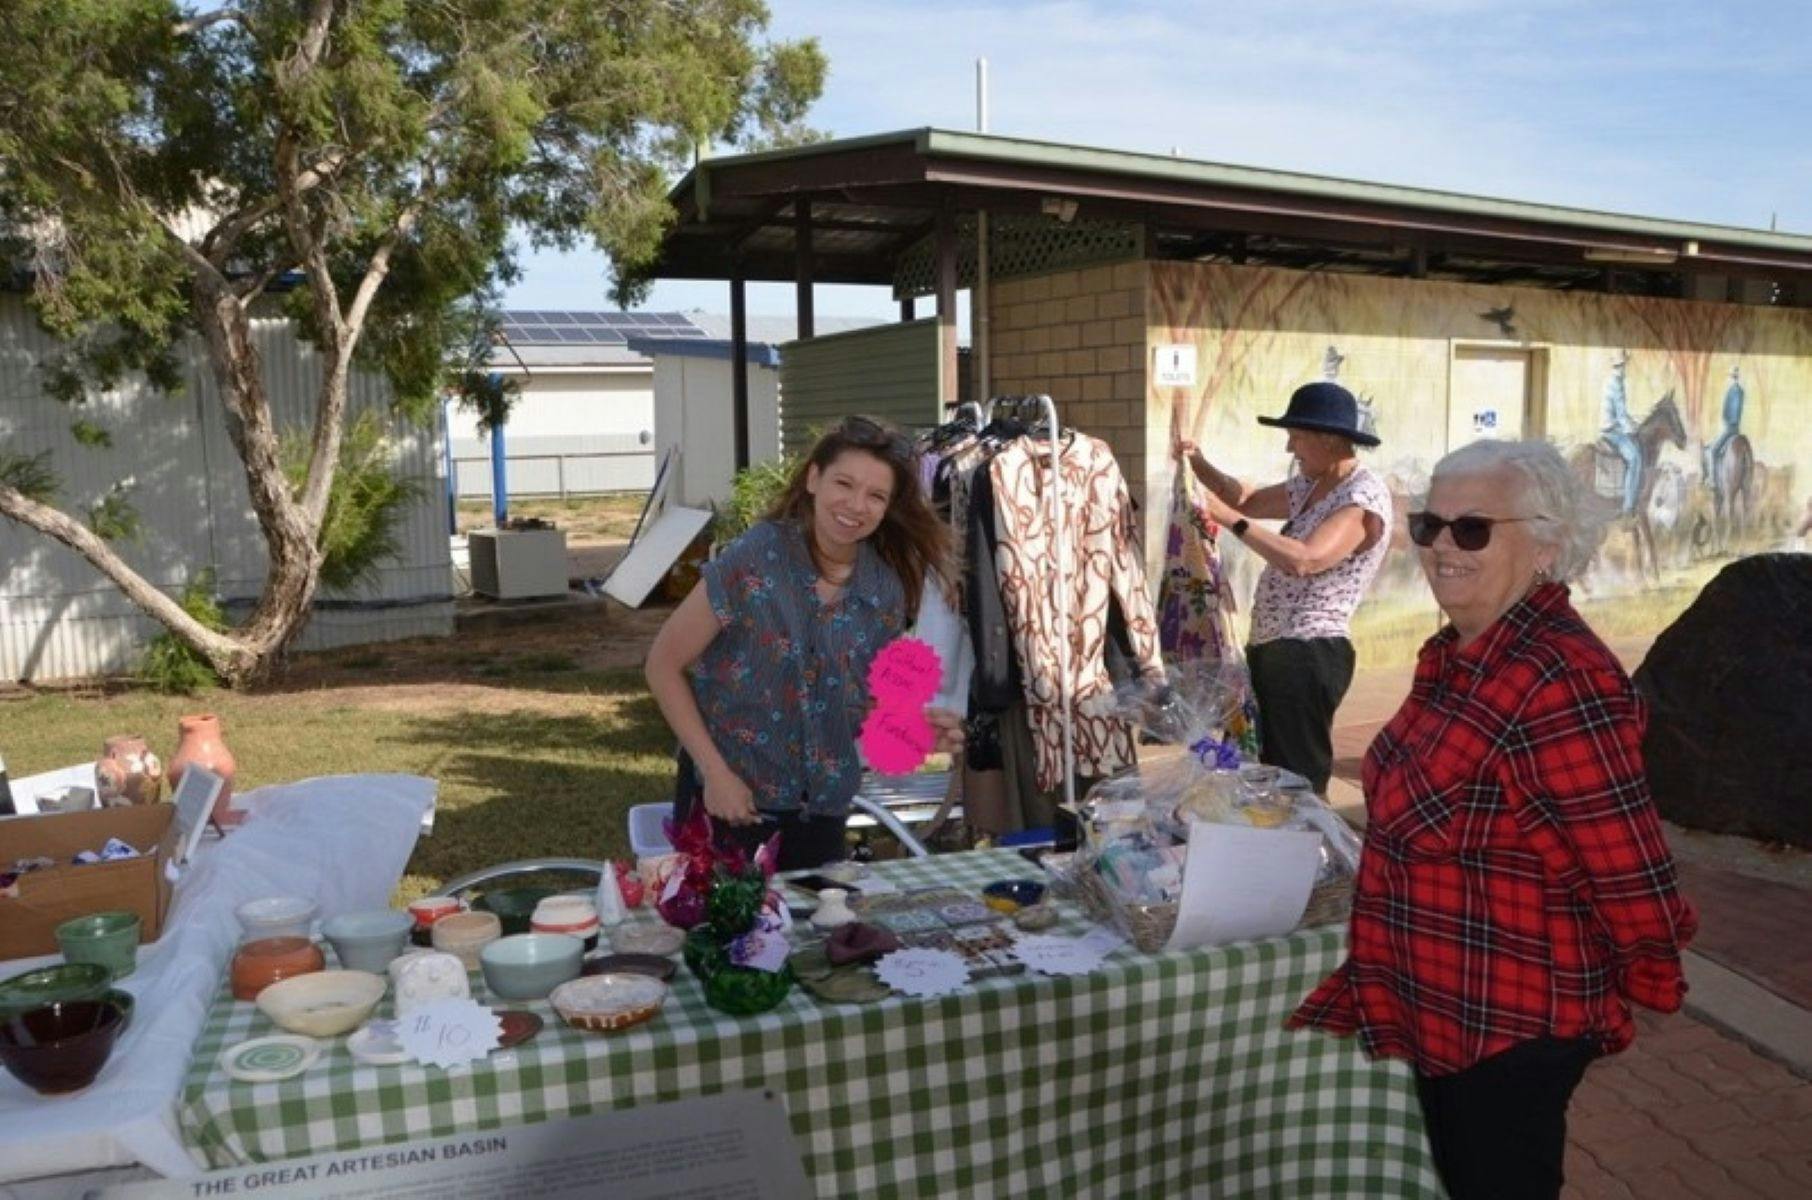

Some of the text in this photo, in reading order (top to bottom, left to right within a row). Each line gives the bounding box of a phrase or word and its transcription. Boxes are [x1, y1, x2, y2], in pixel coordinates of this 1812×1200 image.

[190, 1177, 237, 1198] THE
[243, 1164, 320, 1191] GREAT
[326, 1147, 436, 1178] ARTESIAN
[443, 1136, 508, 1160] BASIN
